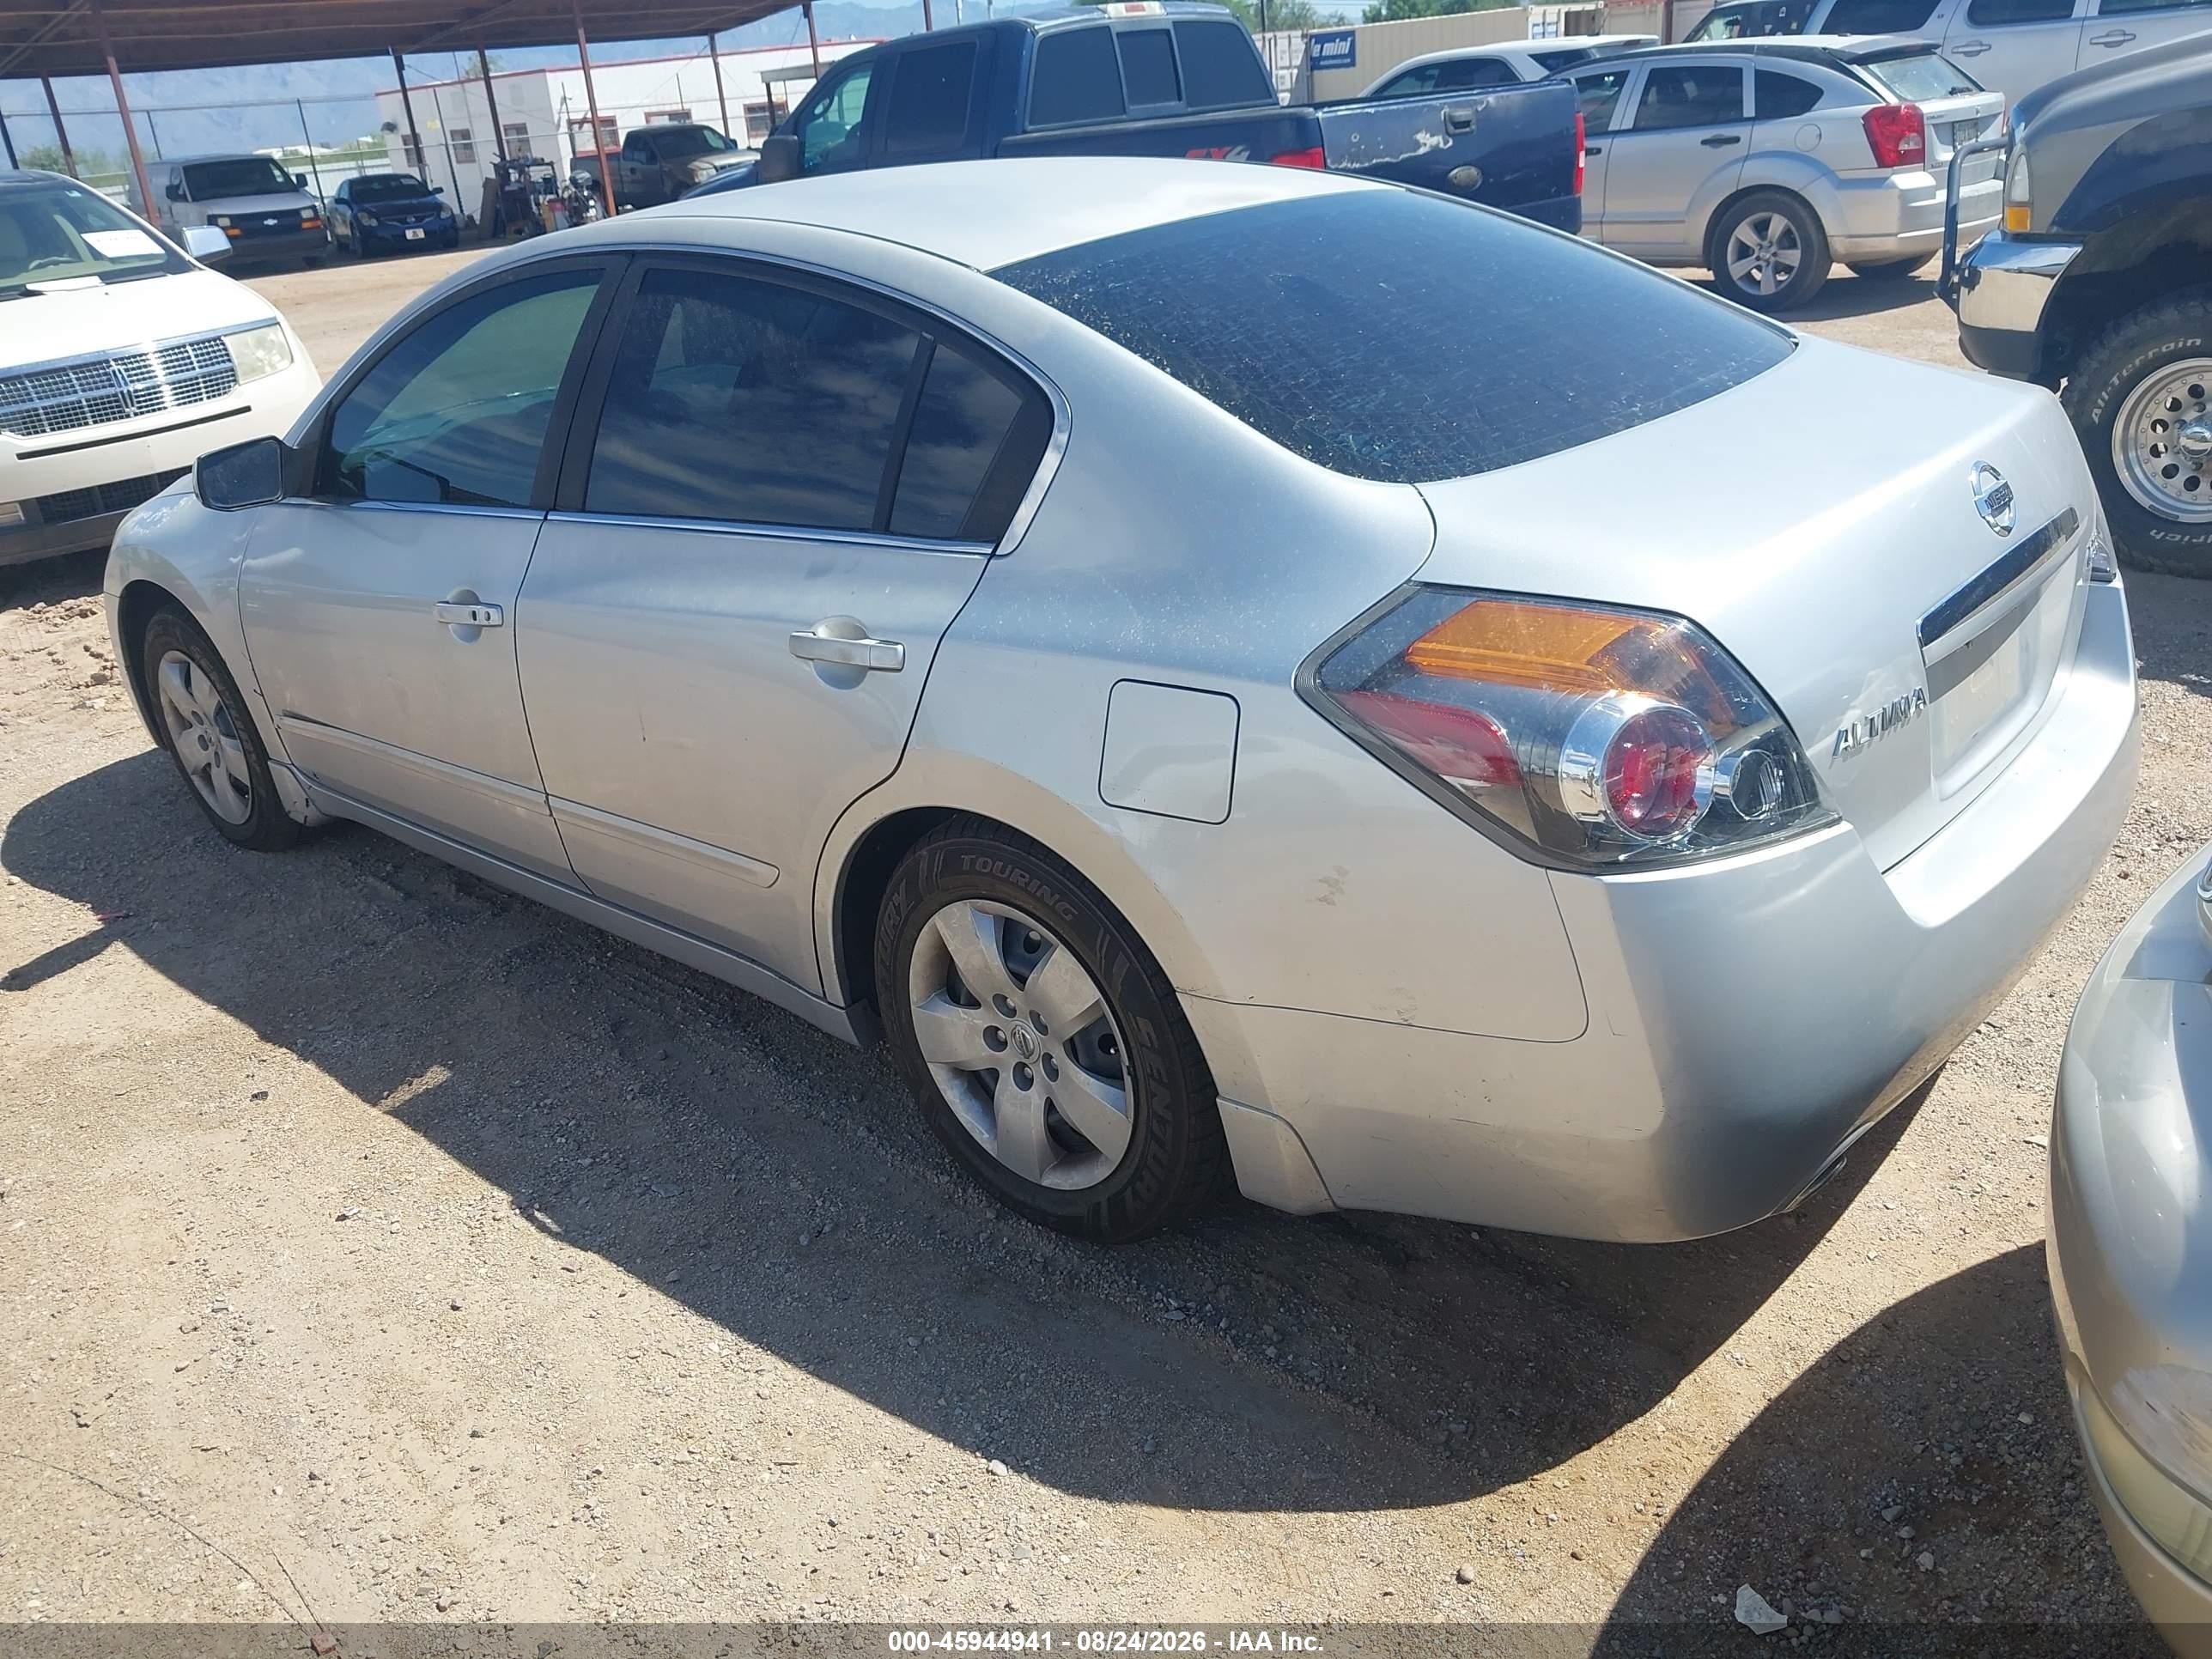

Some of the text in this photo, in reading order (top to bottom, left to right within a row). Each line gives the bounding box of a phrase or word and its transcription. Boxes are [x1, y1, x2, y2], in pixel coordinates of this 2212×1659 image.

[1322, 37, 1352, 57] mini
[2092, 337, 2202, 424] All-Terrain
[2149, 529, 2212, 544] rich
[1832, 686, 1927, 759] ALTIMA
[960, 854, 1079, 921] TOURING
